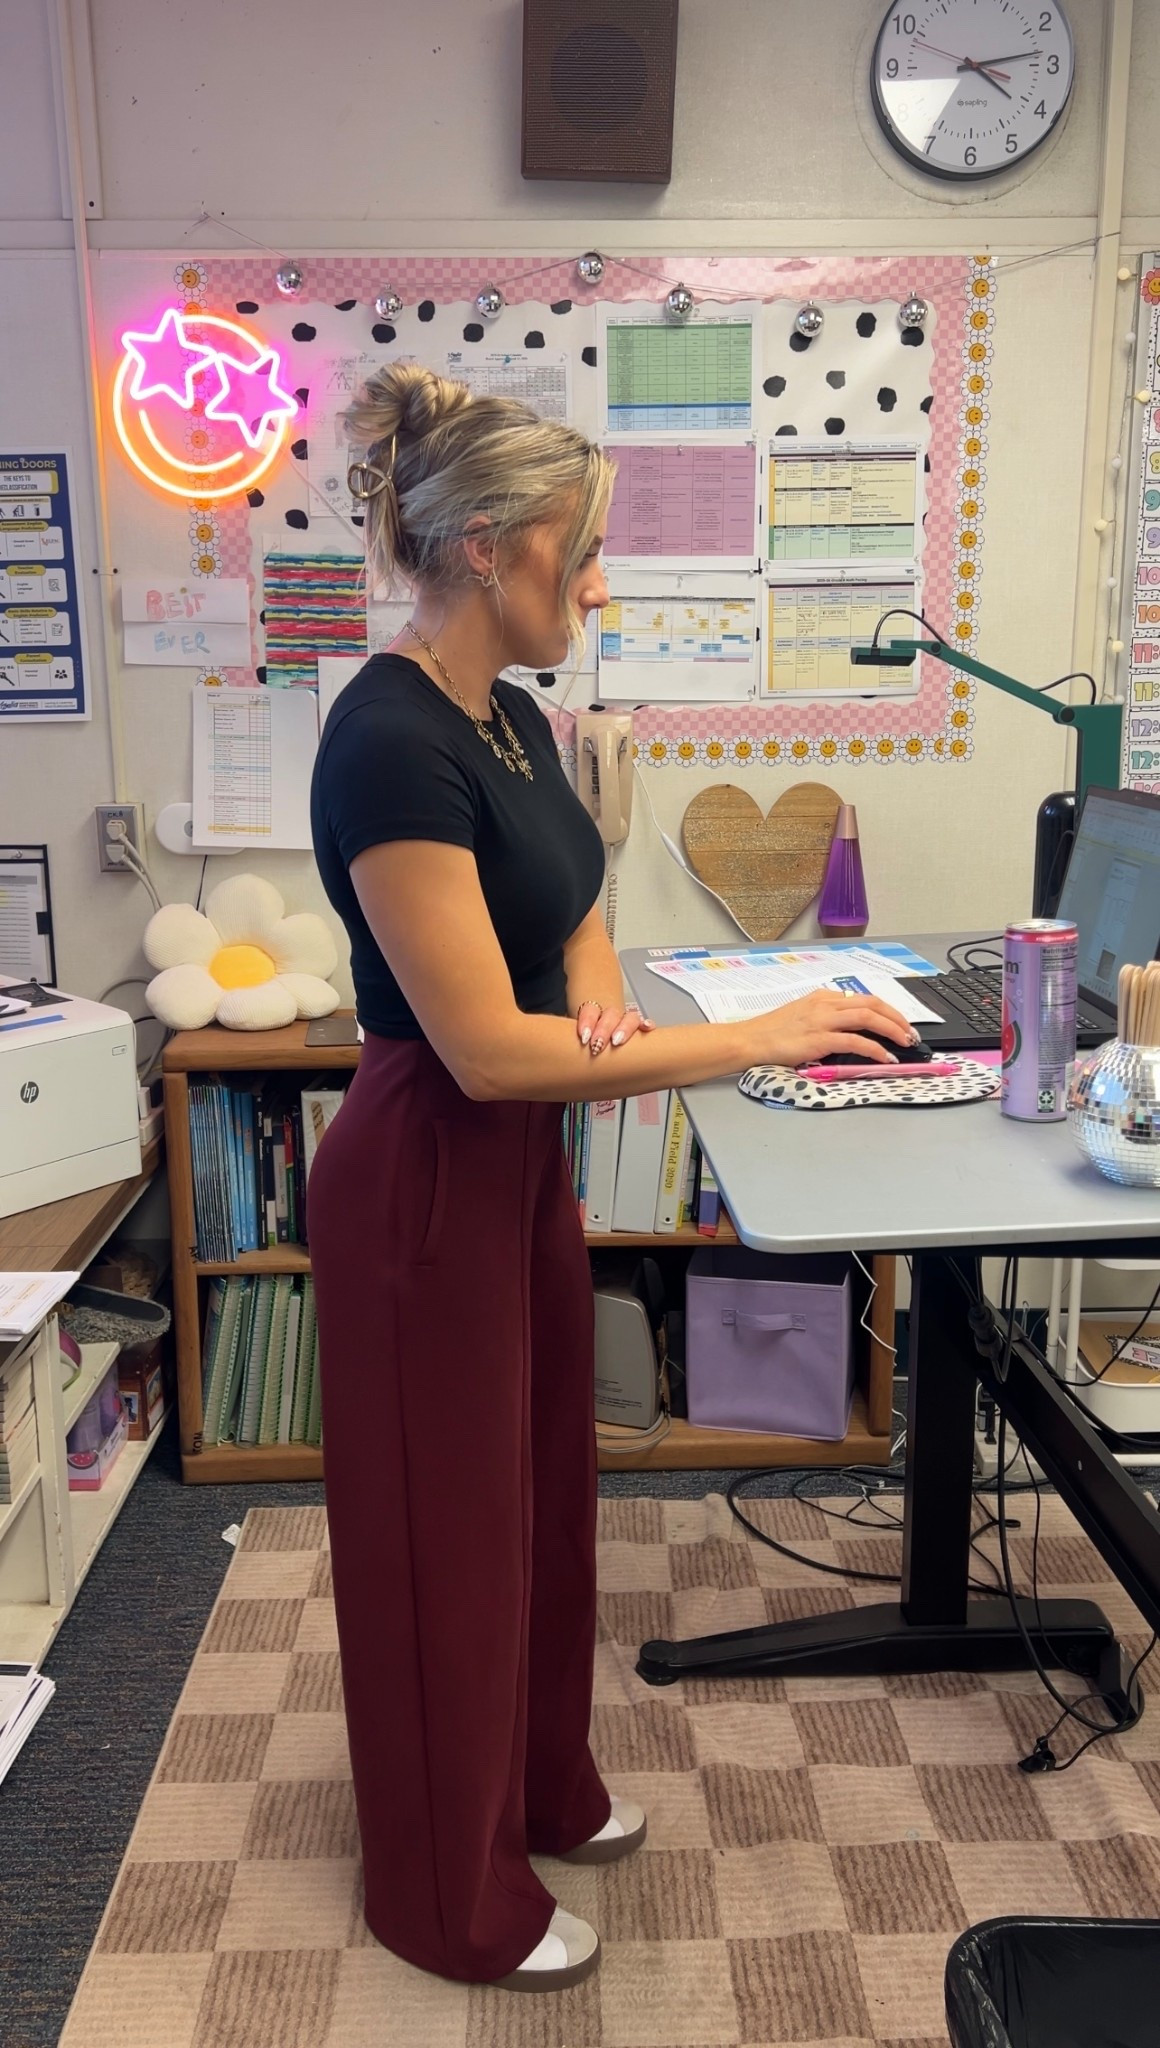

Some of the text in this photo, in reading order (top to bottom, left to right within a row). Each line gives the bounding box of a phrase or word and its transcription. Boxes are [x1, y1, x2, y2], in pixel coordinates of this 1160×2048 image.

[892, 14, 916, 34] 10
[1039, 12, 1052, 31] 2
[886, 58, 899, 78] 9
[1047, 55, 1059, 75] 3
[1033, 99, 1047, 119] 4
[924, 136, 937, 155] 7
[1005, 134, 1018, 153] 5
[964, 146, 977, 166] 6
[0, 458, 57, 469] ING DOORS
[155, 630, 211, 654] EVER
[22, 1081, 38, 1103] hp
[671, 1121, 681, 1139] and
[667, 1141, 680, 1165] Field
[664, 1167, 676, 1189] 2020
